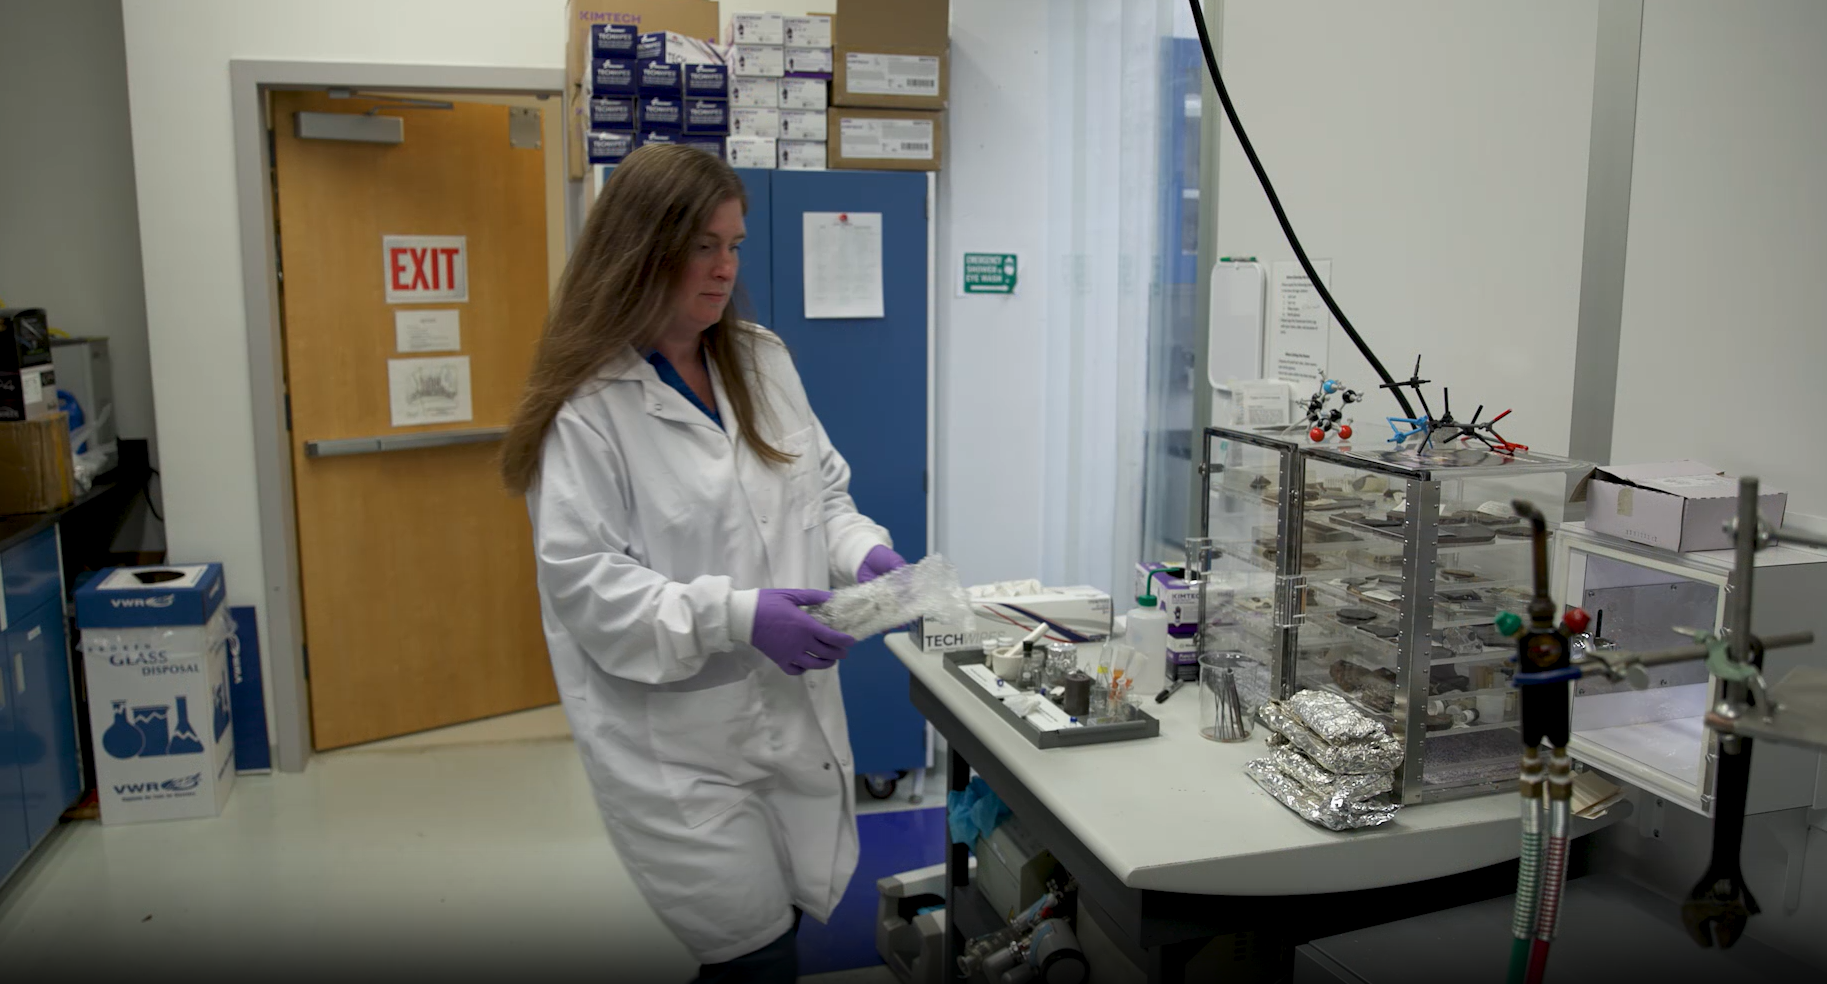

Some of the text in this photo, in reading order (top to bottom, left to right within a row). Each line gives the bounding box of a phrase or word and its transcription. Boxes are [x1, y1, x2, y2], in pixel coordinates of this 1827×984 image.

[579, 11, 641, 23] KIMTECH
[966, 255, 1002, 264] EMERGENCY
[389, 247, 460, 291] EXIT
[966, 274, 1003, 283] EYE WASH
[110, 598, 145, 608] VWR
[109, 650, 168, 667] GLASS
[142, 664, 199, 676] DISPOSAL
[113, 782, 159, 795] VWR
